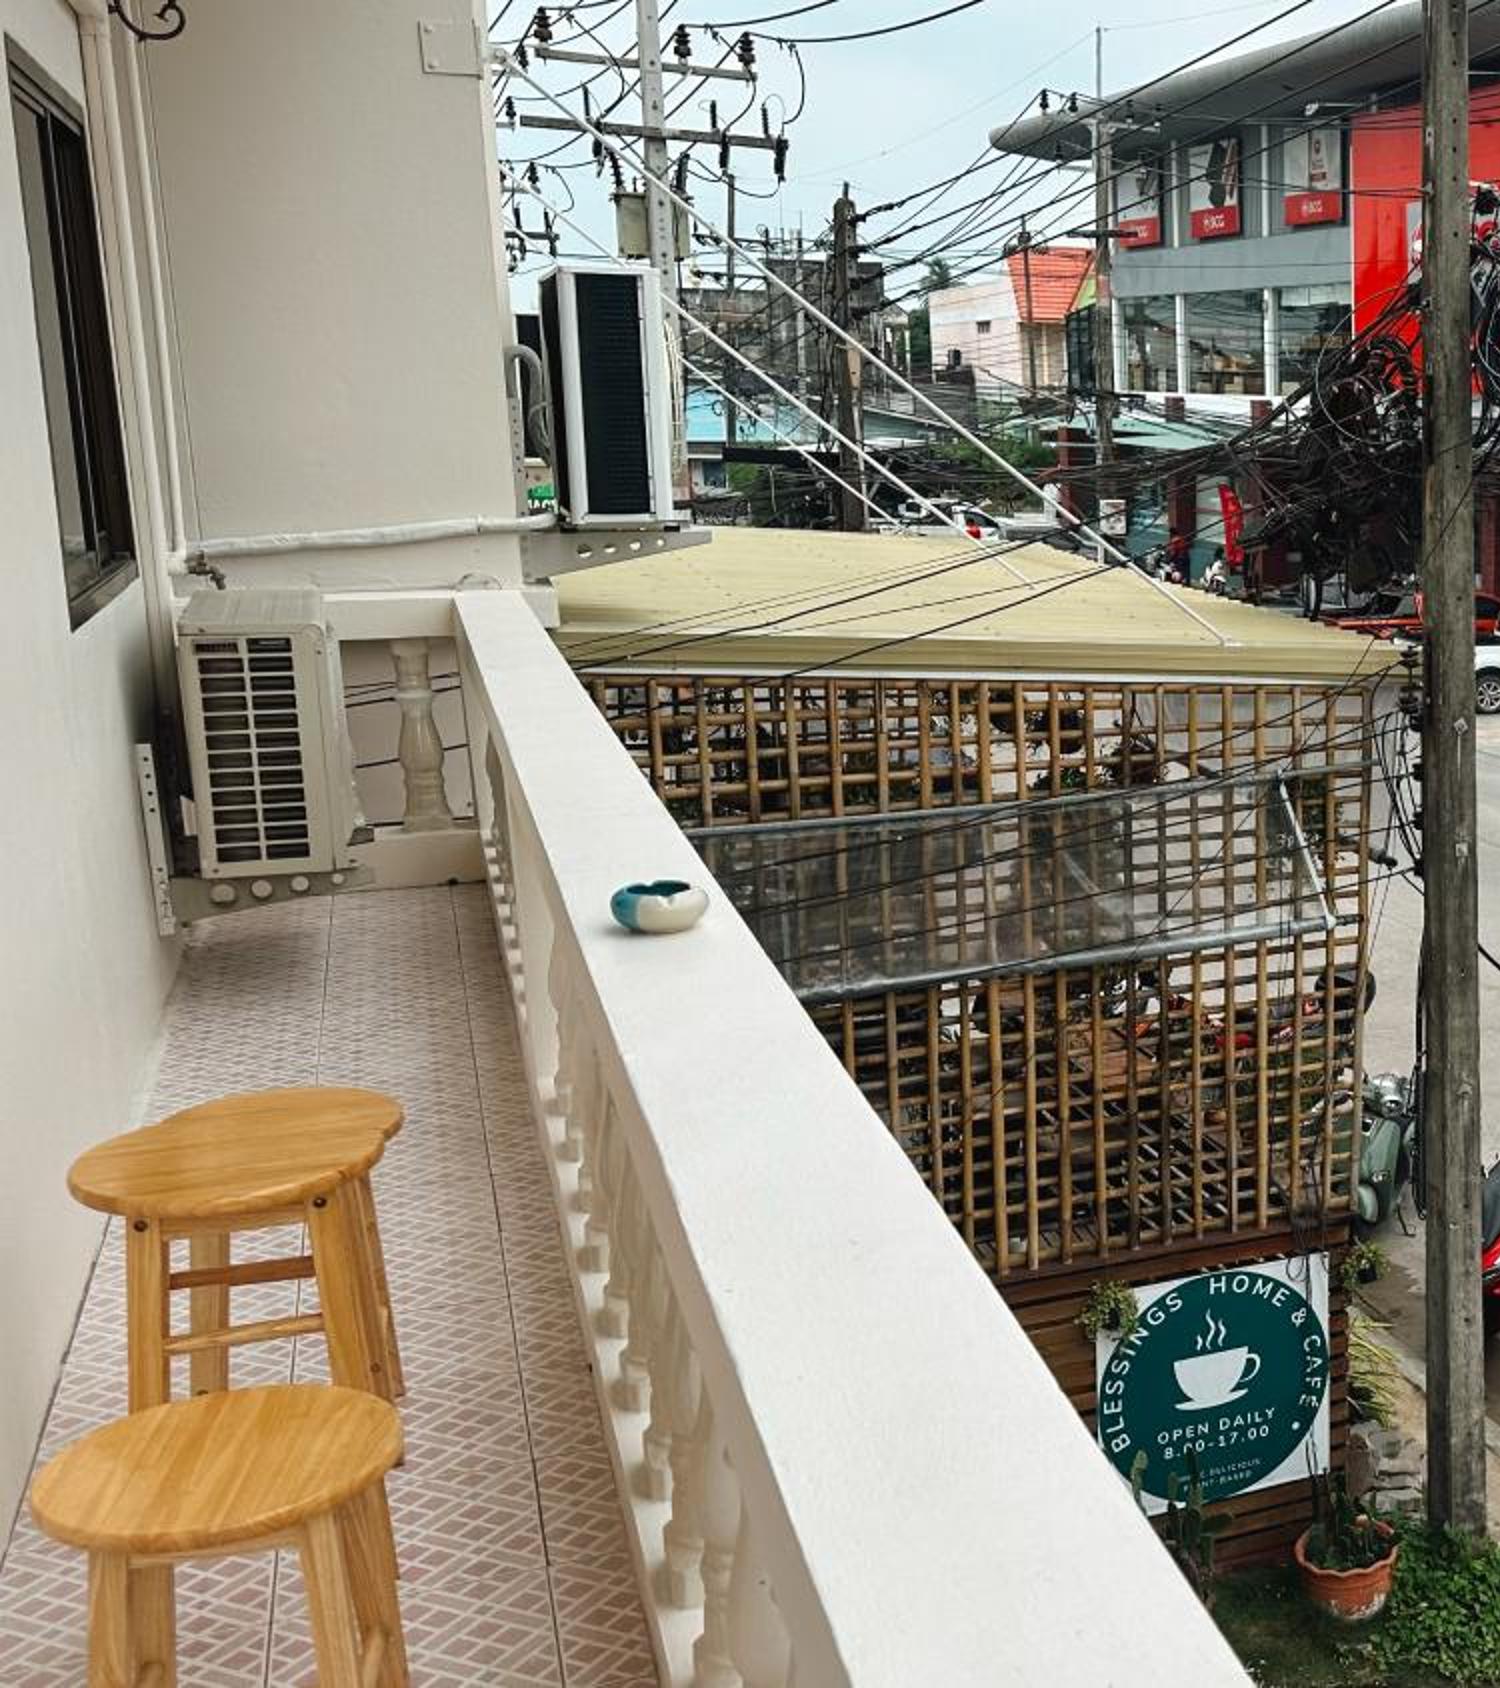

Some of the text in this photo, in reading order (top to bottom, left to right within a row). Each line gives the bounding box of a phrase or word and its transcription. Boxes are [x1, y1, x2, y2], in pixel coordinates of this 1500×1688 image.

[1103, 1292, 1183, 1453] BLESSINGS
[1209, 1275, 1291, 1308] HOME
[1291, 1307, 1308, 1328] &
[1157, 1407, 1275, 1445] OPEN DAILY
